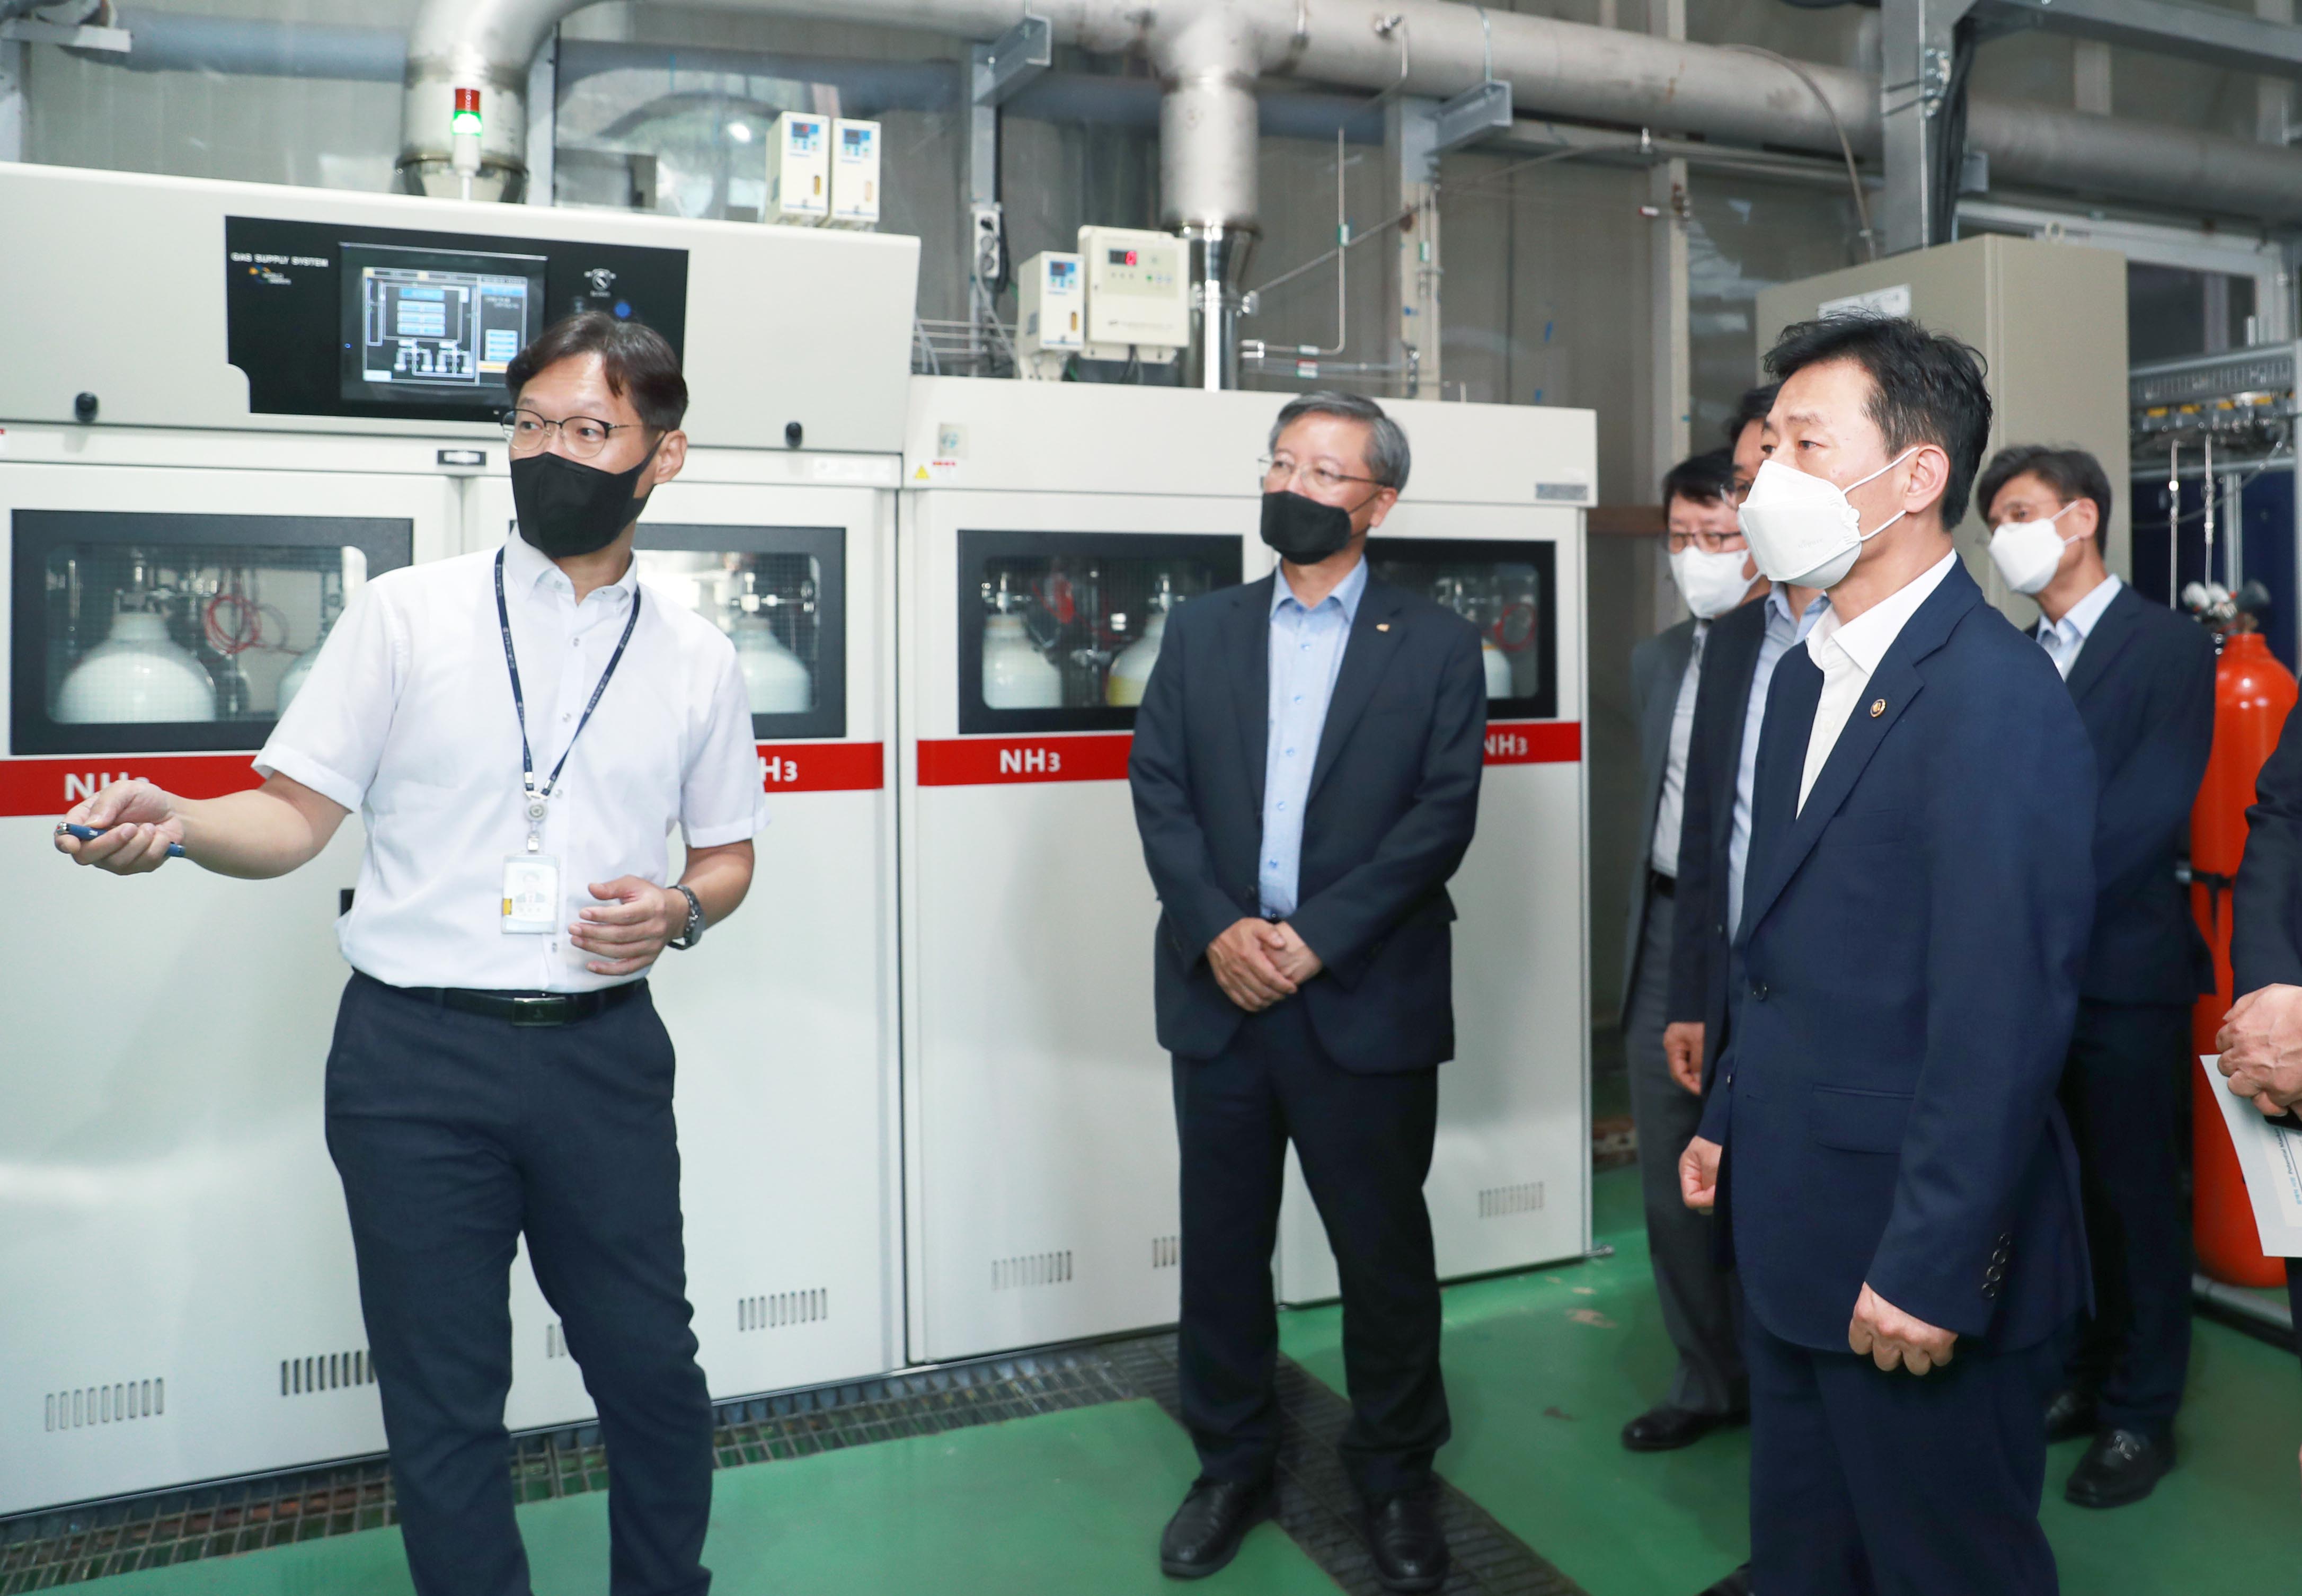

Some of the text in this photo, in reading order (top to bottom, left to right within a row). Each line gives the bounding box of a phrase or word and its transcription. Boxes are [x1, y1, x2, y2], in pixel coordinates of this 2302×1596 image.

[231, 252, 329, 268] GAS SUPPLY SYSTEM
[758, 756, 798, 783] H3
[999, 747, 1061, 774] NH3
